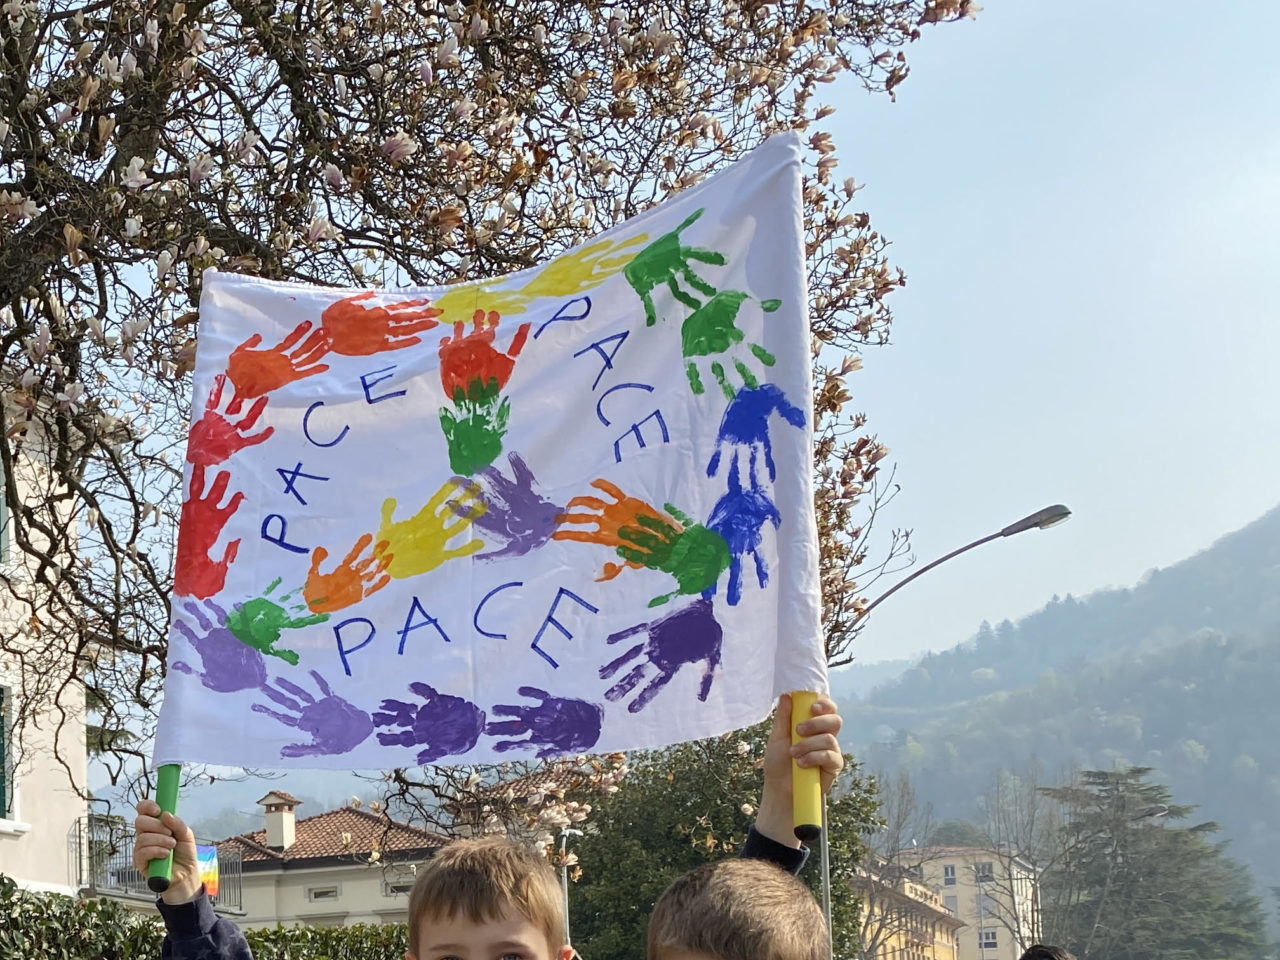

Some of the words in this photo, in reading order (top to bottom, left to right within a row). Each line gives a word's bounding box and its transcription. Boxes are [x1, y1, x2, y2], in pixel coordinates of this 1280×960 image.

[261, 365, 407, 554] PACE
[534, 296, 670, 463] PACE
[333, 581, 599, 676] PACE
